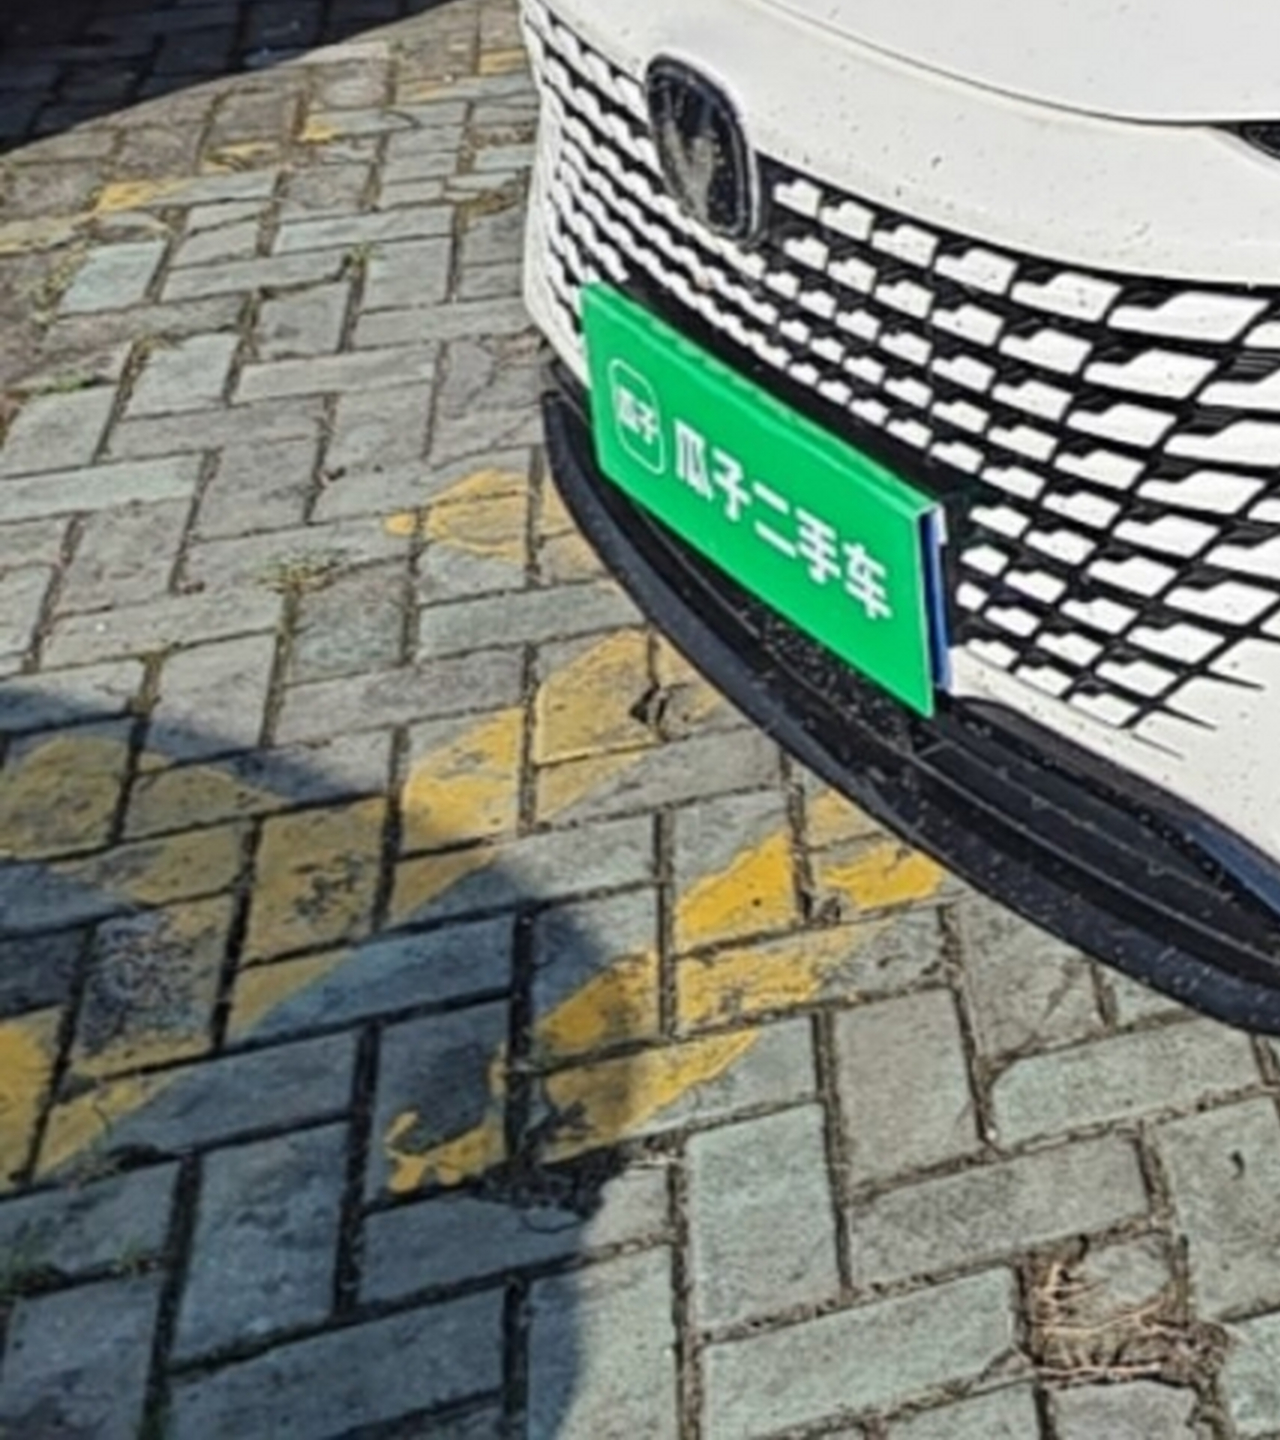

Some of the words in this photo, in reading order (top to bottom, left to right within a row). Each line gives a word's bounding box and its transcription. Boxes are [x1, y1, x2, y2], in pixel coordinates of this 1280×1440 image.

[674, 419, 892, 620] 瓜子二手车
